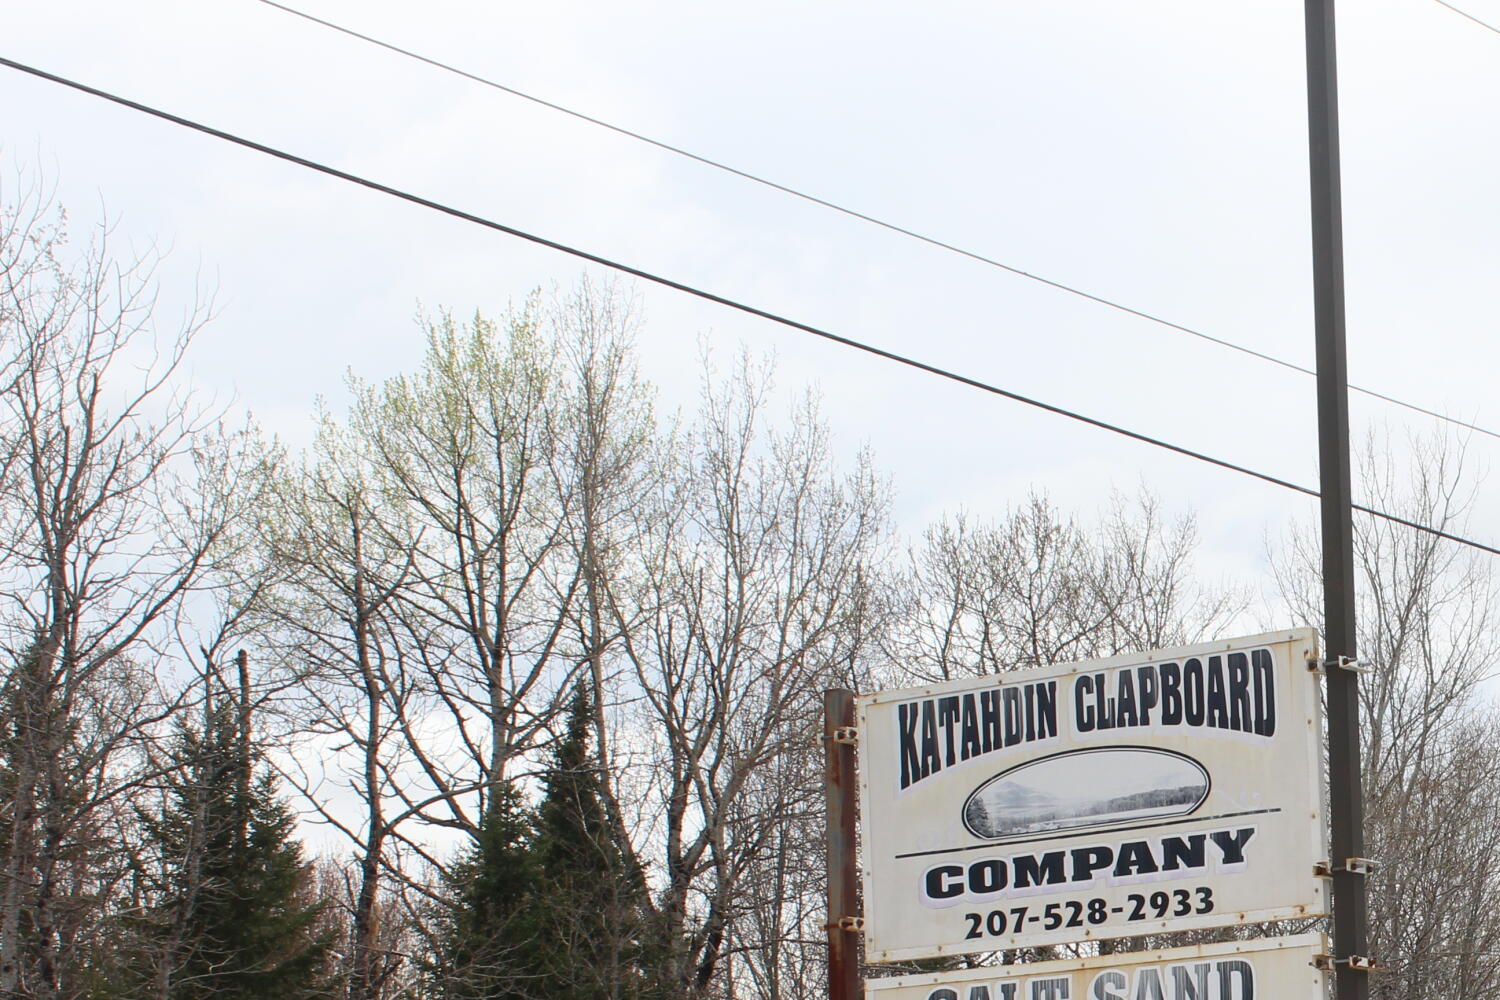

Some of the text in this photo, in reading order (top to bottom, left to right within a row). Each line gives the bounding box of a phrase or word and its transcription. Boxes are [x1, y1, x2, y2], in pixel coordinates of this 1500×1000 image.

[898, 649, 1276, 790] KATAHDIN CLAPBOARD
[926, 828, 1255, 899] COMPANY
[965, 887, 1214, 939] 207-528-2933
